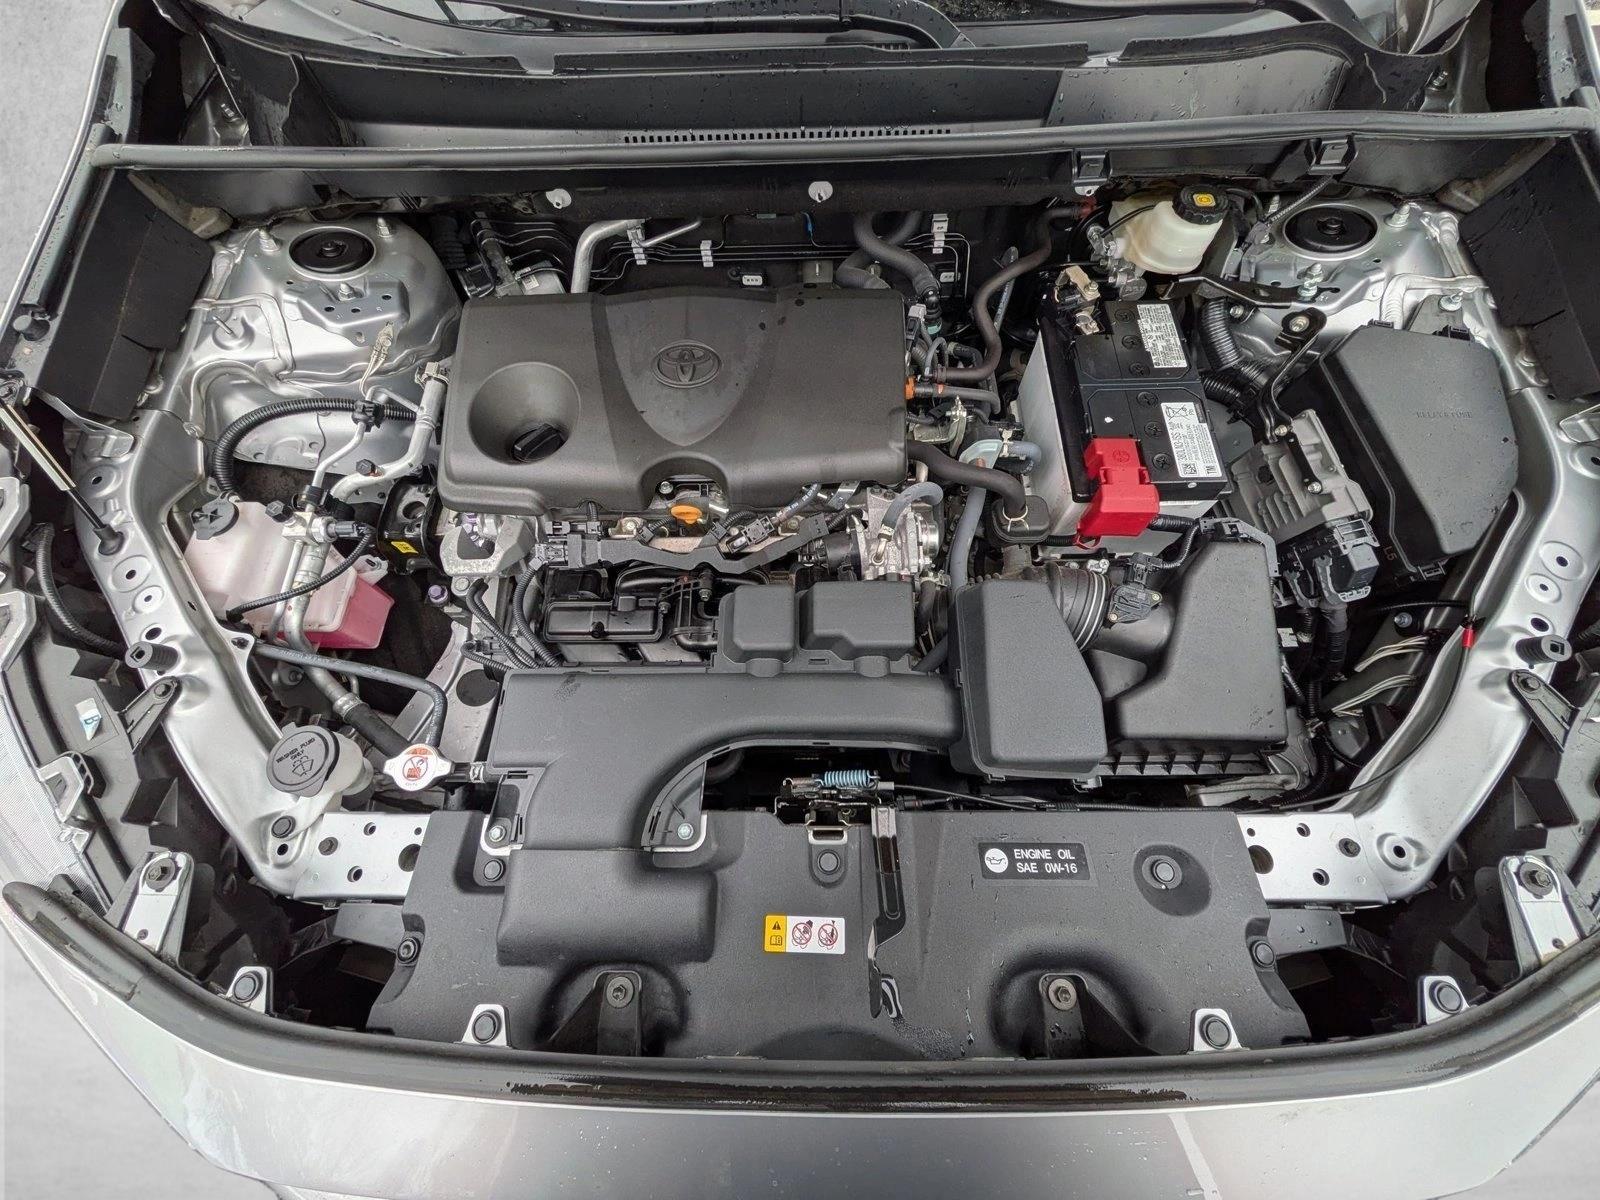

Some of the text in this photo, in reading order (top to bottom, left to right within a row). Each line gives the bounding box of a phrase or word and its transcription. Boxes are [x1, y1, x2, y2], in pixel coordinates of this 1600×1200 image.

[1013, 849, 1075, 860] ENGINE OIL
[1016, 863, 1078, 874] SAE 0W-16
